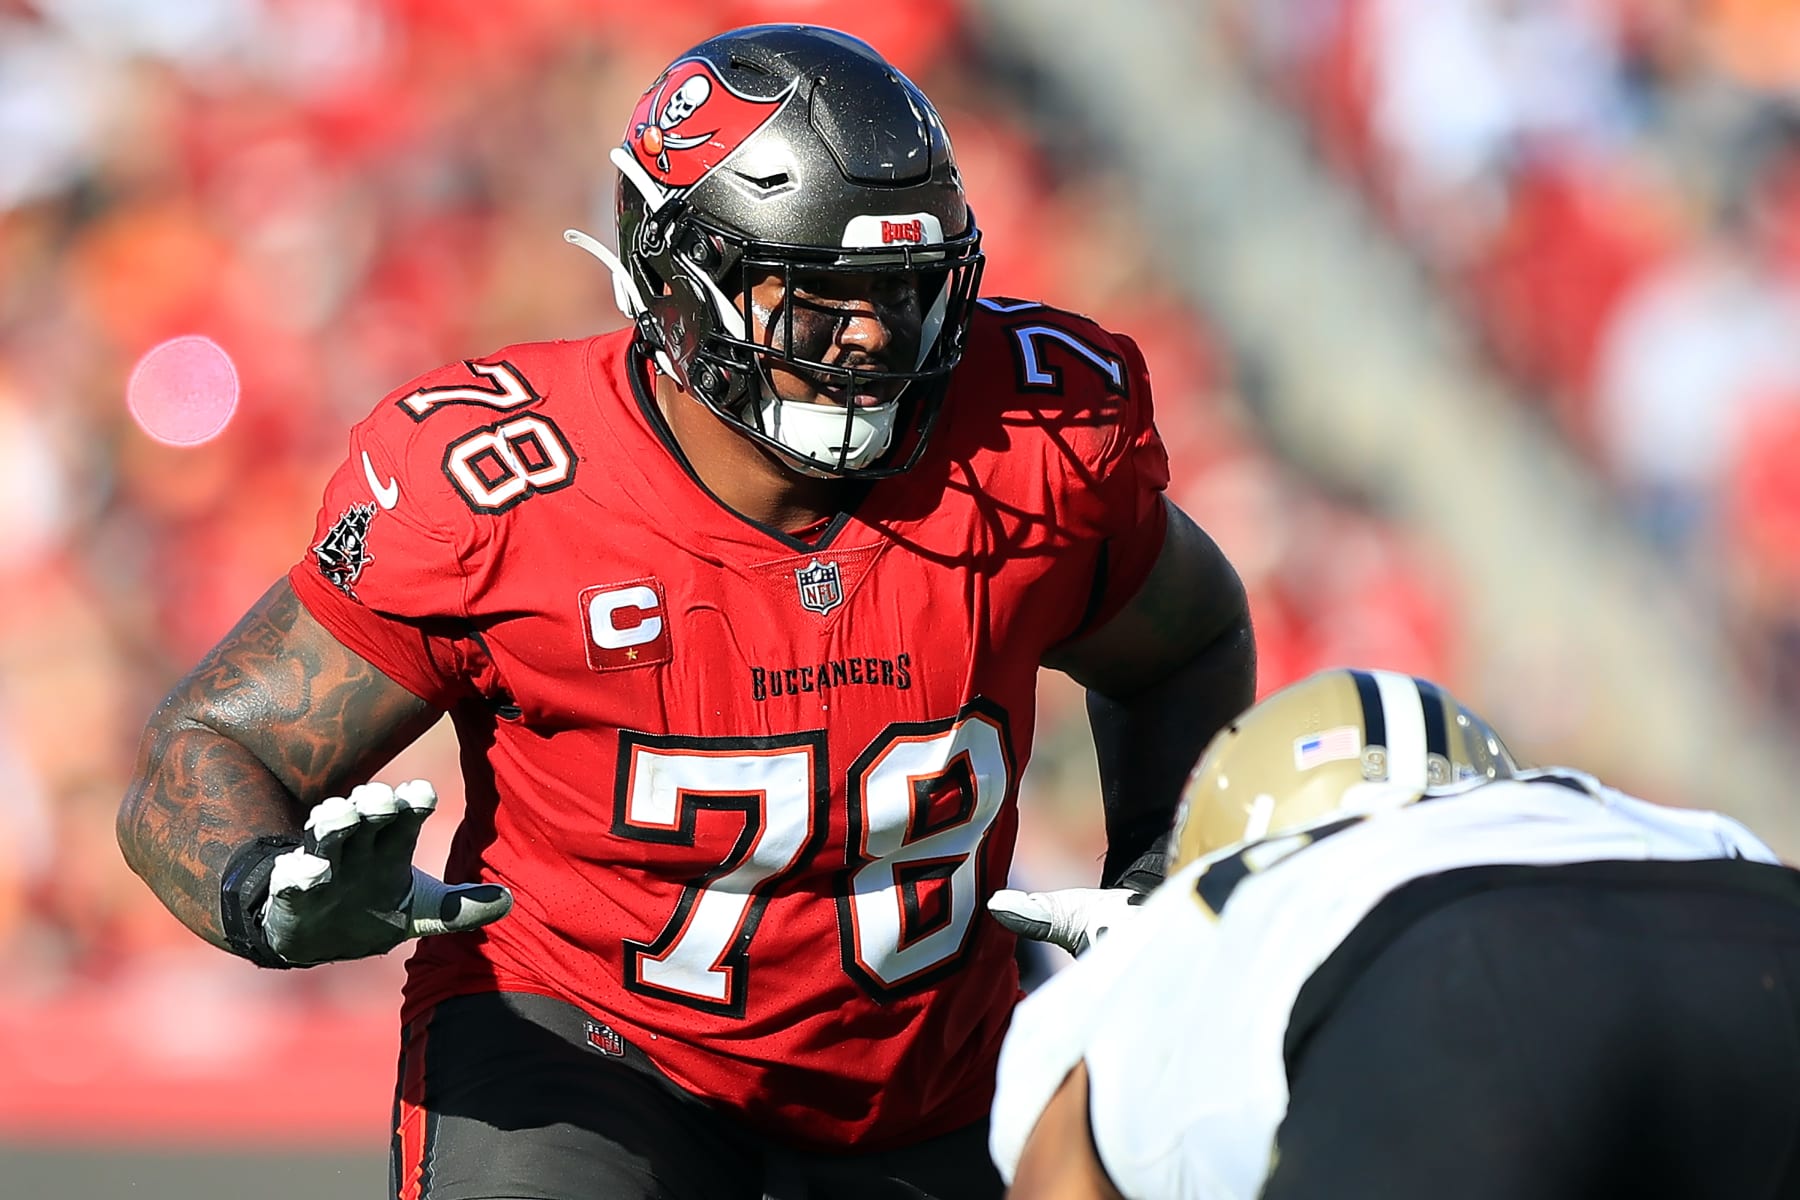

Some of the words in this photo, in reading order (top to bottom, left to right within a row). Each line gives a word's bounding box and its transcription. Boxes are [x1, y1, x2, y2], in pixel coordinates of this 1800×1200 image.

[395, 360, 578, 515] 78
[588, 585, 662, 650] C
[805, 582, 837, 606] NFL
[751, 653, 911, 701] BUCCANEERS
[610, 694, 1017, 1019] 78
